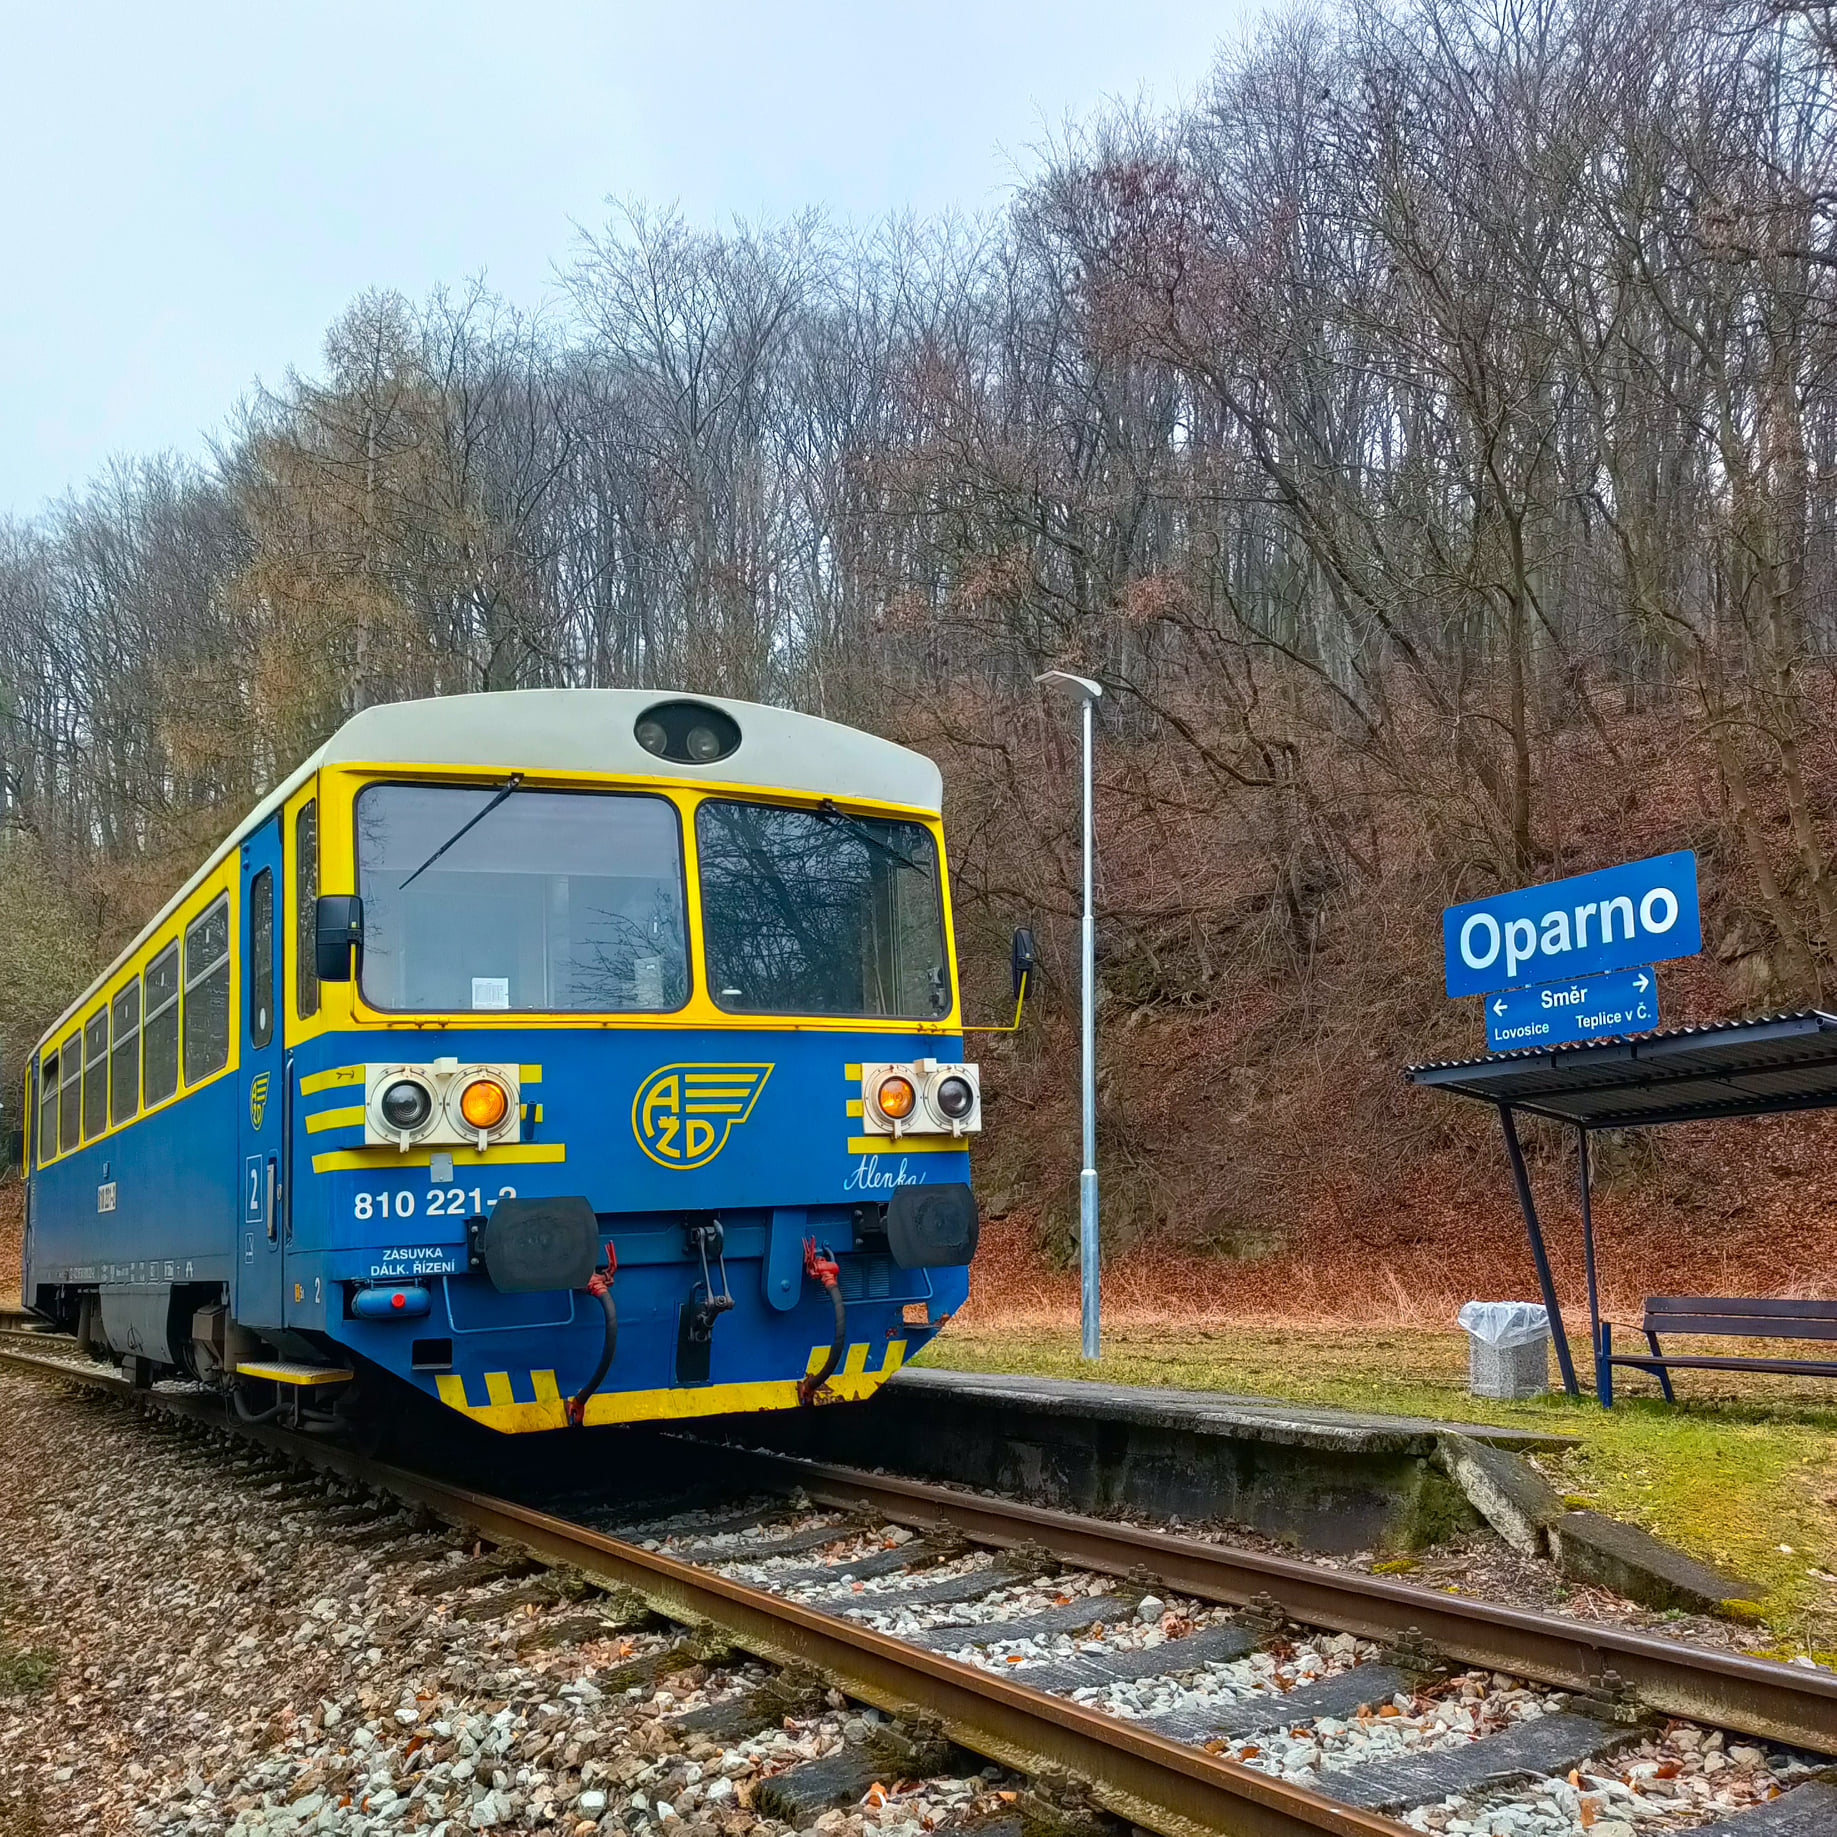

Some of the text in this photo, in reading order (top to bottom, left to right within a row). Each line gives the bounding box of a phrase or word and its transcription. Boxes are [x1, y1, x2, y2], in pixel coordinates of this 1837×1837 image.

[1460, 887, 1679, 978] Oparno
[1541, 985, 1588, 1009] Směr
[1575, 1001, 1652, 1030] Teplice v Č.
[1494, 1022, 1550, 1041] Lovosice
[250, 1168, 259, 1210] 2
[354, 1191, 415, 1219] 810
[371, 1258, 456, 1277] DÁLK. ŘÍZENÍ
[314, 1276, 322, 1304] 2
